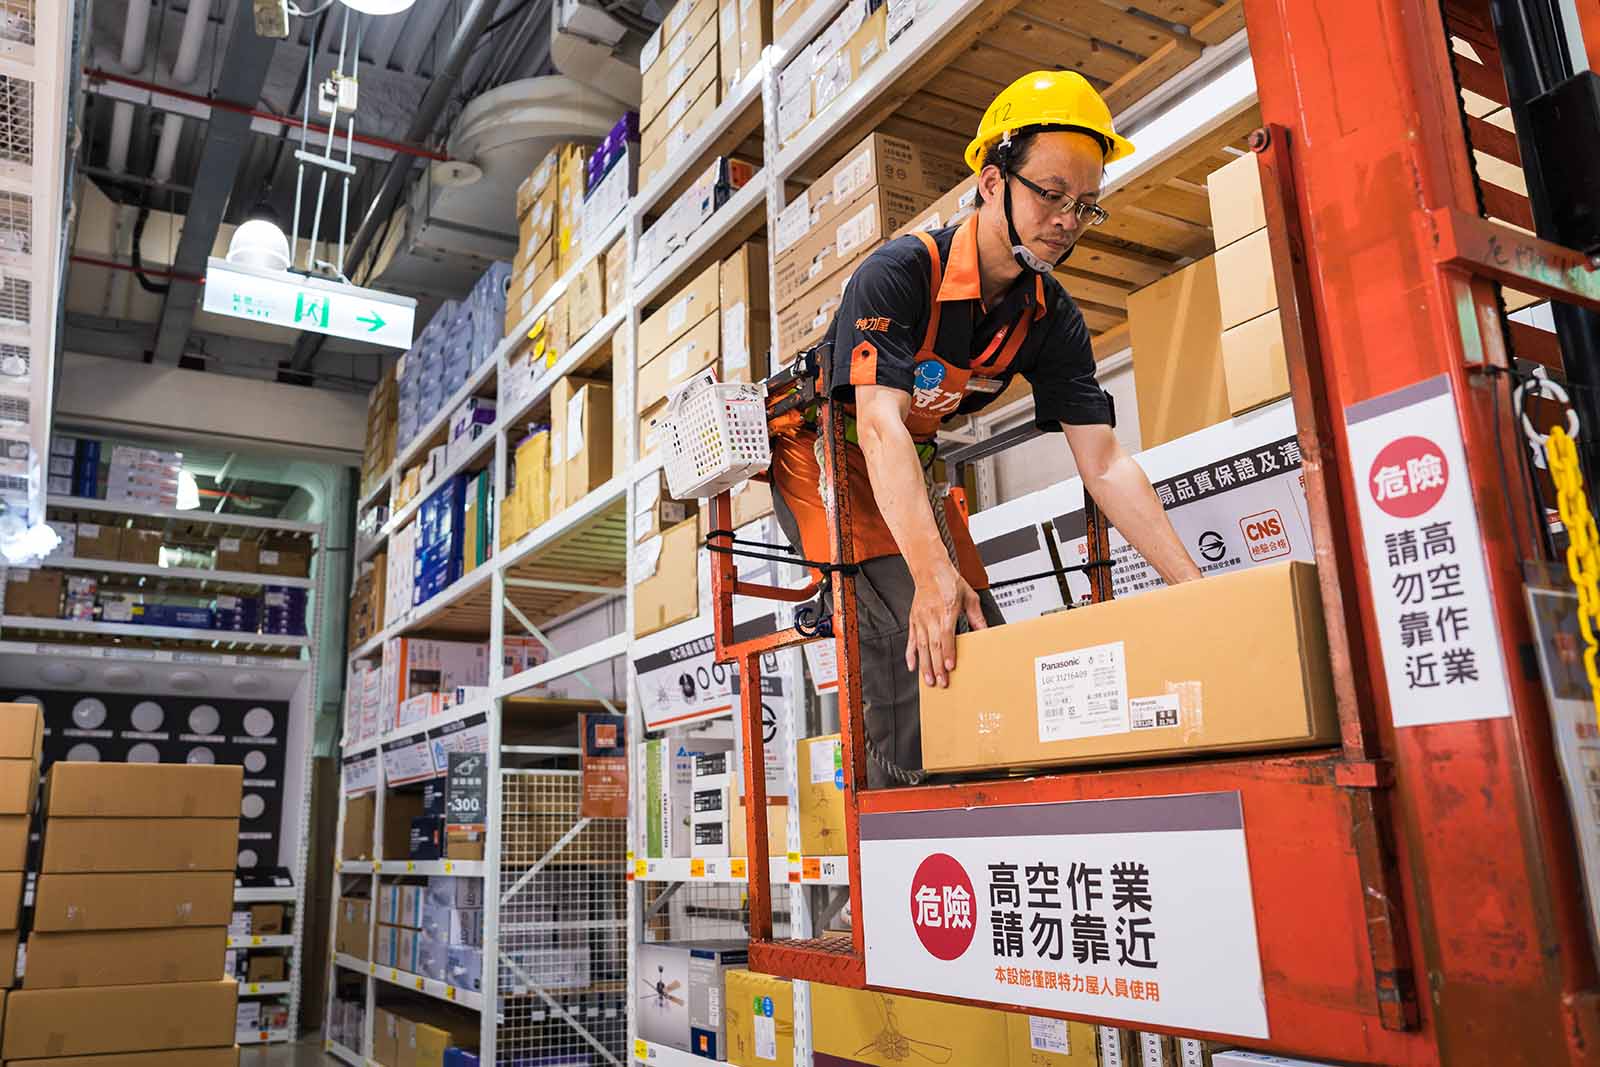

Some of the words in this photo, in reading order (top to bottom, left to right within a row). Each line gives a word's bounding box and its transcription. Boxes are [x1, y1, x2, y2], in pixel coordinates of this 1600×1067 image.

[855, 317, 891, 332] 特力屋
[1373, 453, 1445, 502] 危險
[1246, 518, 1281, 542] CNS
[1385, 529, 1441, 690] 請勿靠近
[1420, 520, 1479, 685] 高空作業
[1041, 656, 1080, 671] Panasonic
[914, 884, 972, 930] 危險
[987, 861, 1152, 913] 高空作業
[991, 910, 1158, 969] 請勿靠近
[994, 965, 1160, 1002] 本設施僅限特力屋人員使用
